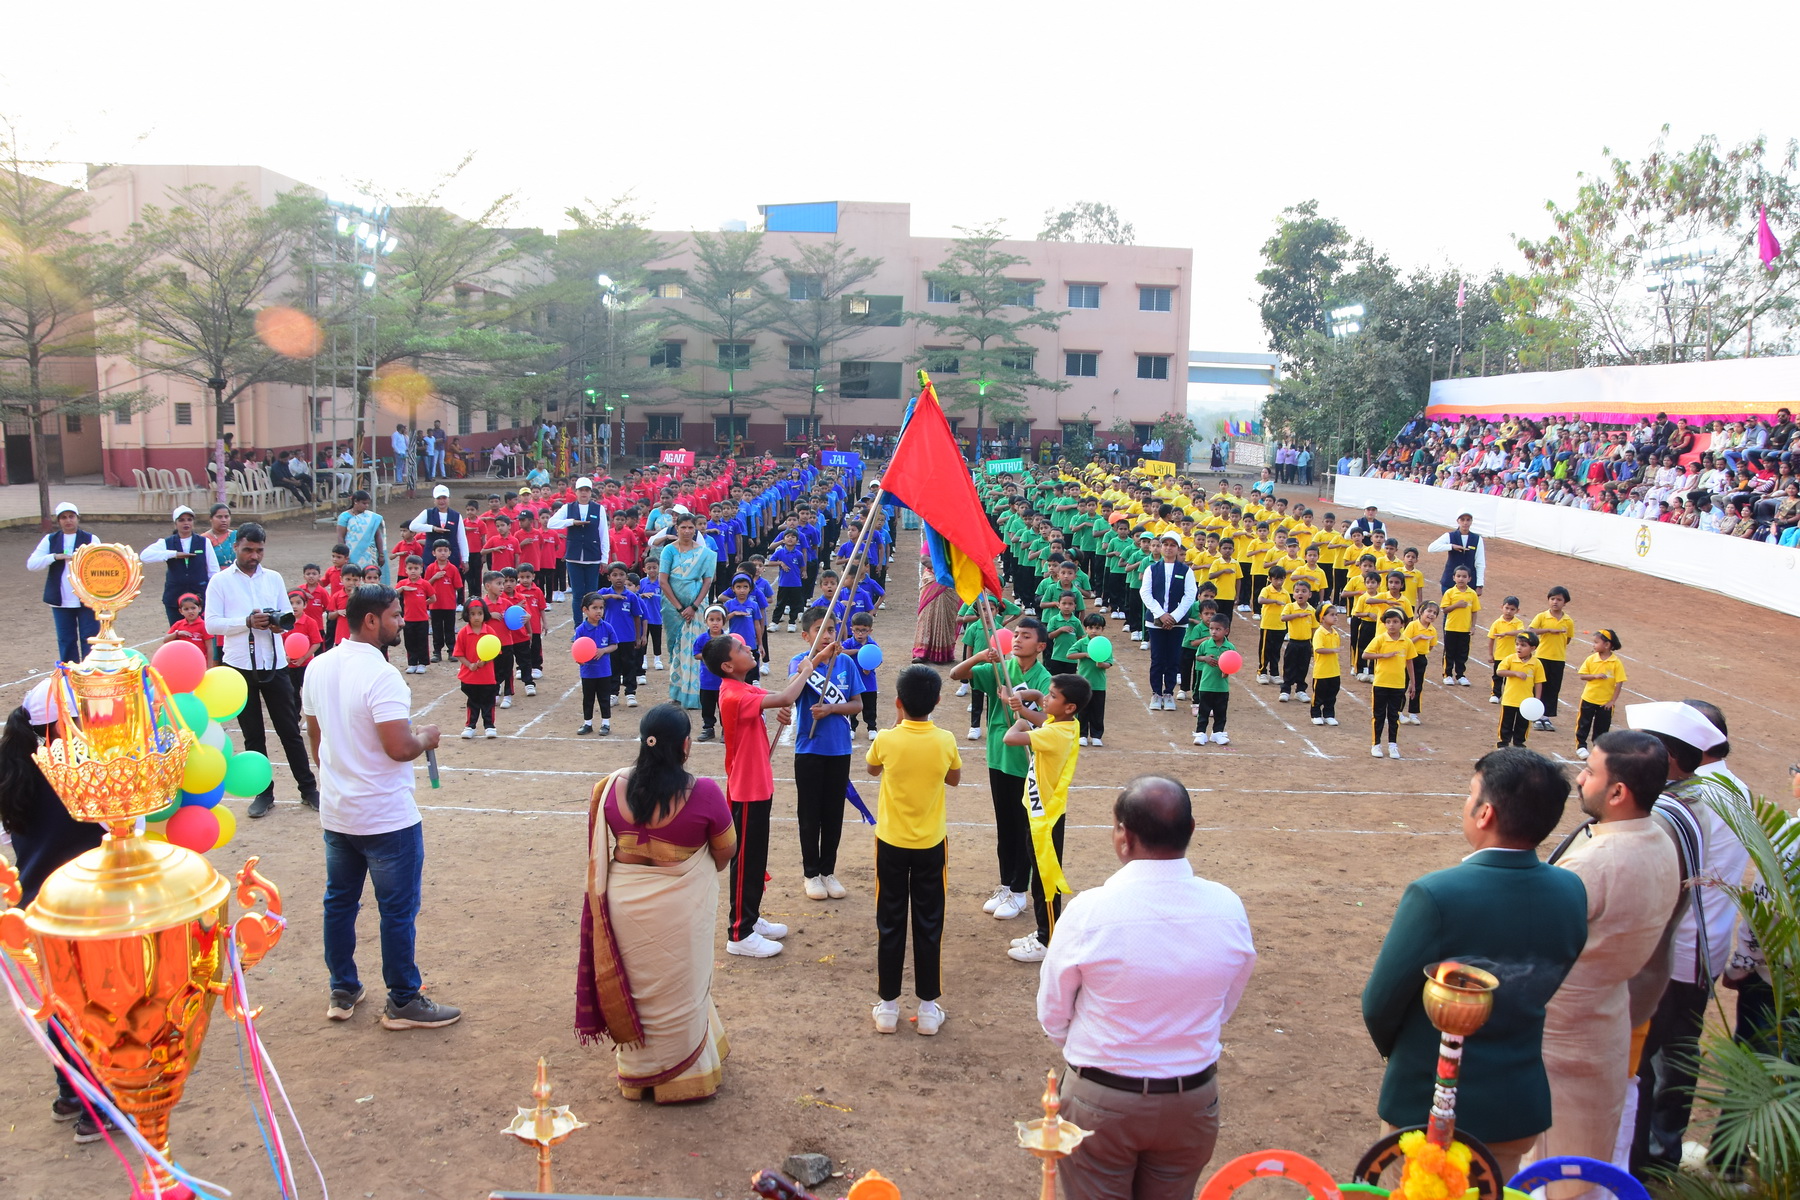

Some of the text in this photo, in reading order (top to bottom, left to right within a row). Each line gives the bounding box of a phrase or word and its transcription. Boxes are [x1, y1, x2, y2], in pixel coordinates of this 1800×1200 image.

[663, 453, 686, 464] AGNI
[829, 454, 848, 465] JAL
[90, 569, 120, 577] WINNER
[809, 672, 843, 704] CAPT
